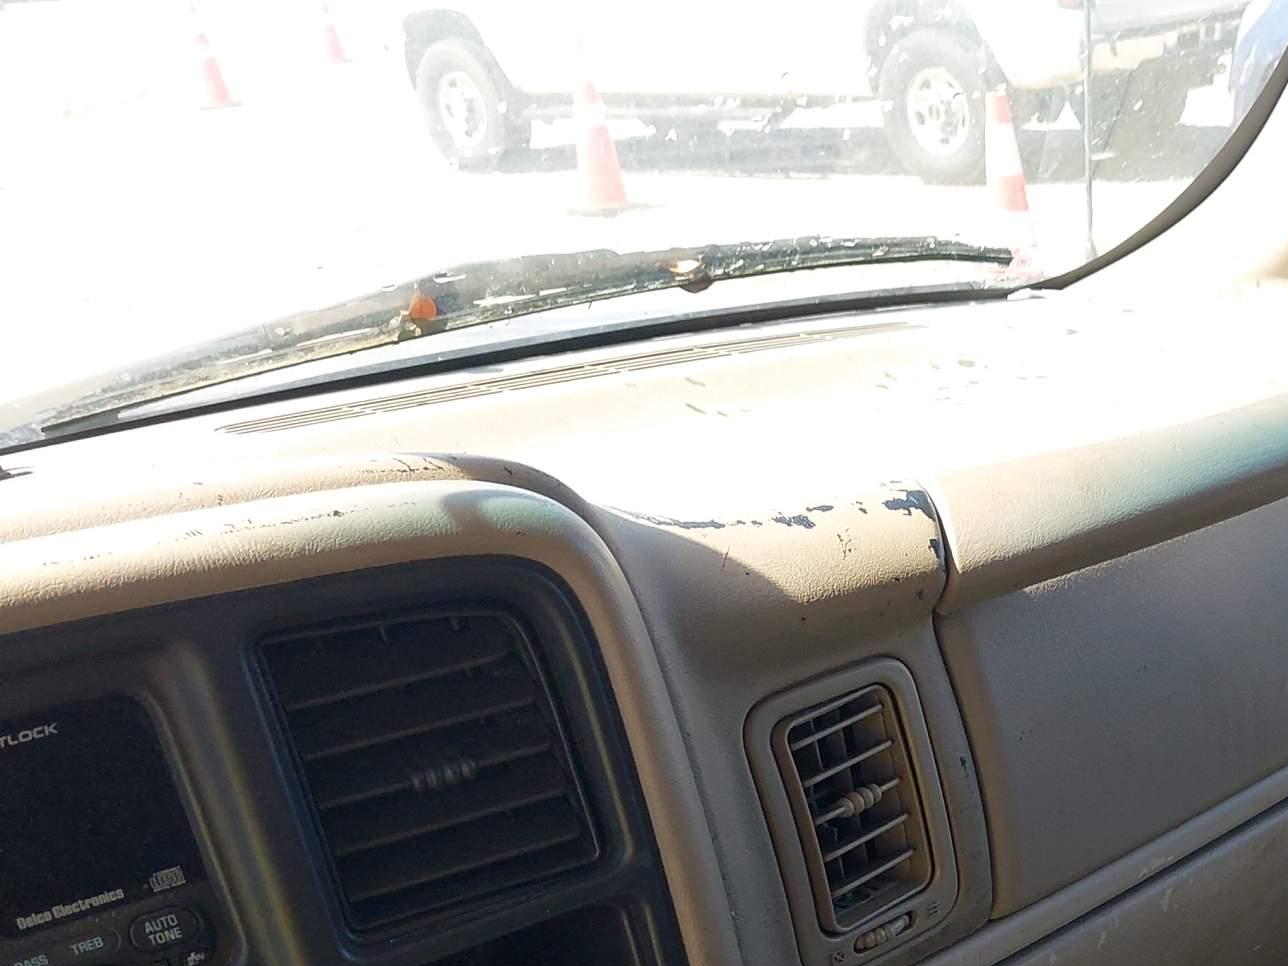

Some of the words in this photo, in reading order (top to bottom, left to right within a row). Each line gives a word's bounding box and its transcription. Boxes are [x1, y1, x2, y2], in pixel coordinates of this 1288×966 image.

[16, 910, 52, 930] Delco
[52, 888, 125, 918] Electronics
[144, 914, 178, 934] AUTO
[70, 936, 104, 956] TREB
[148, 927, 183, 946] TONE
